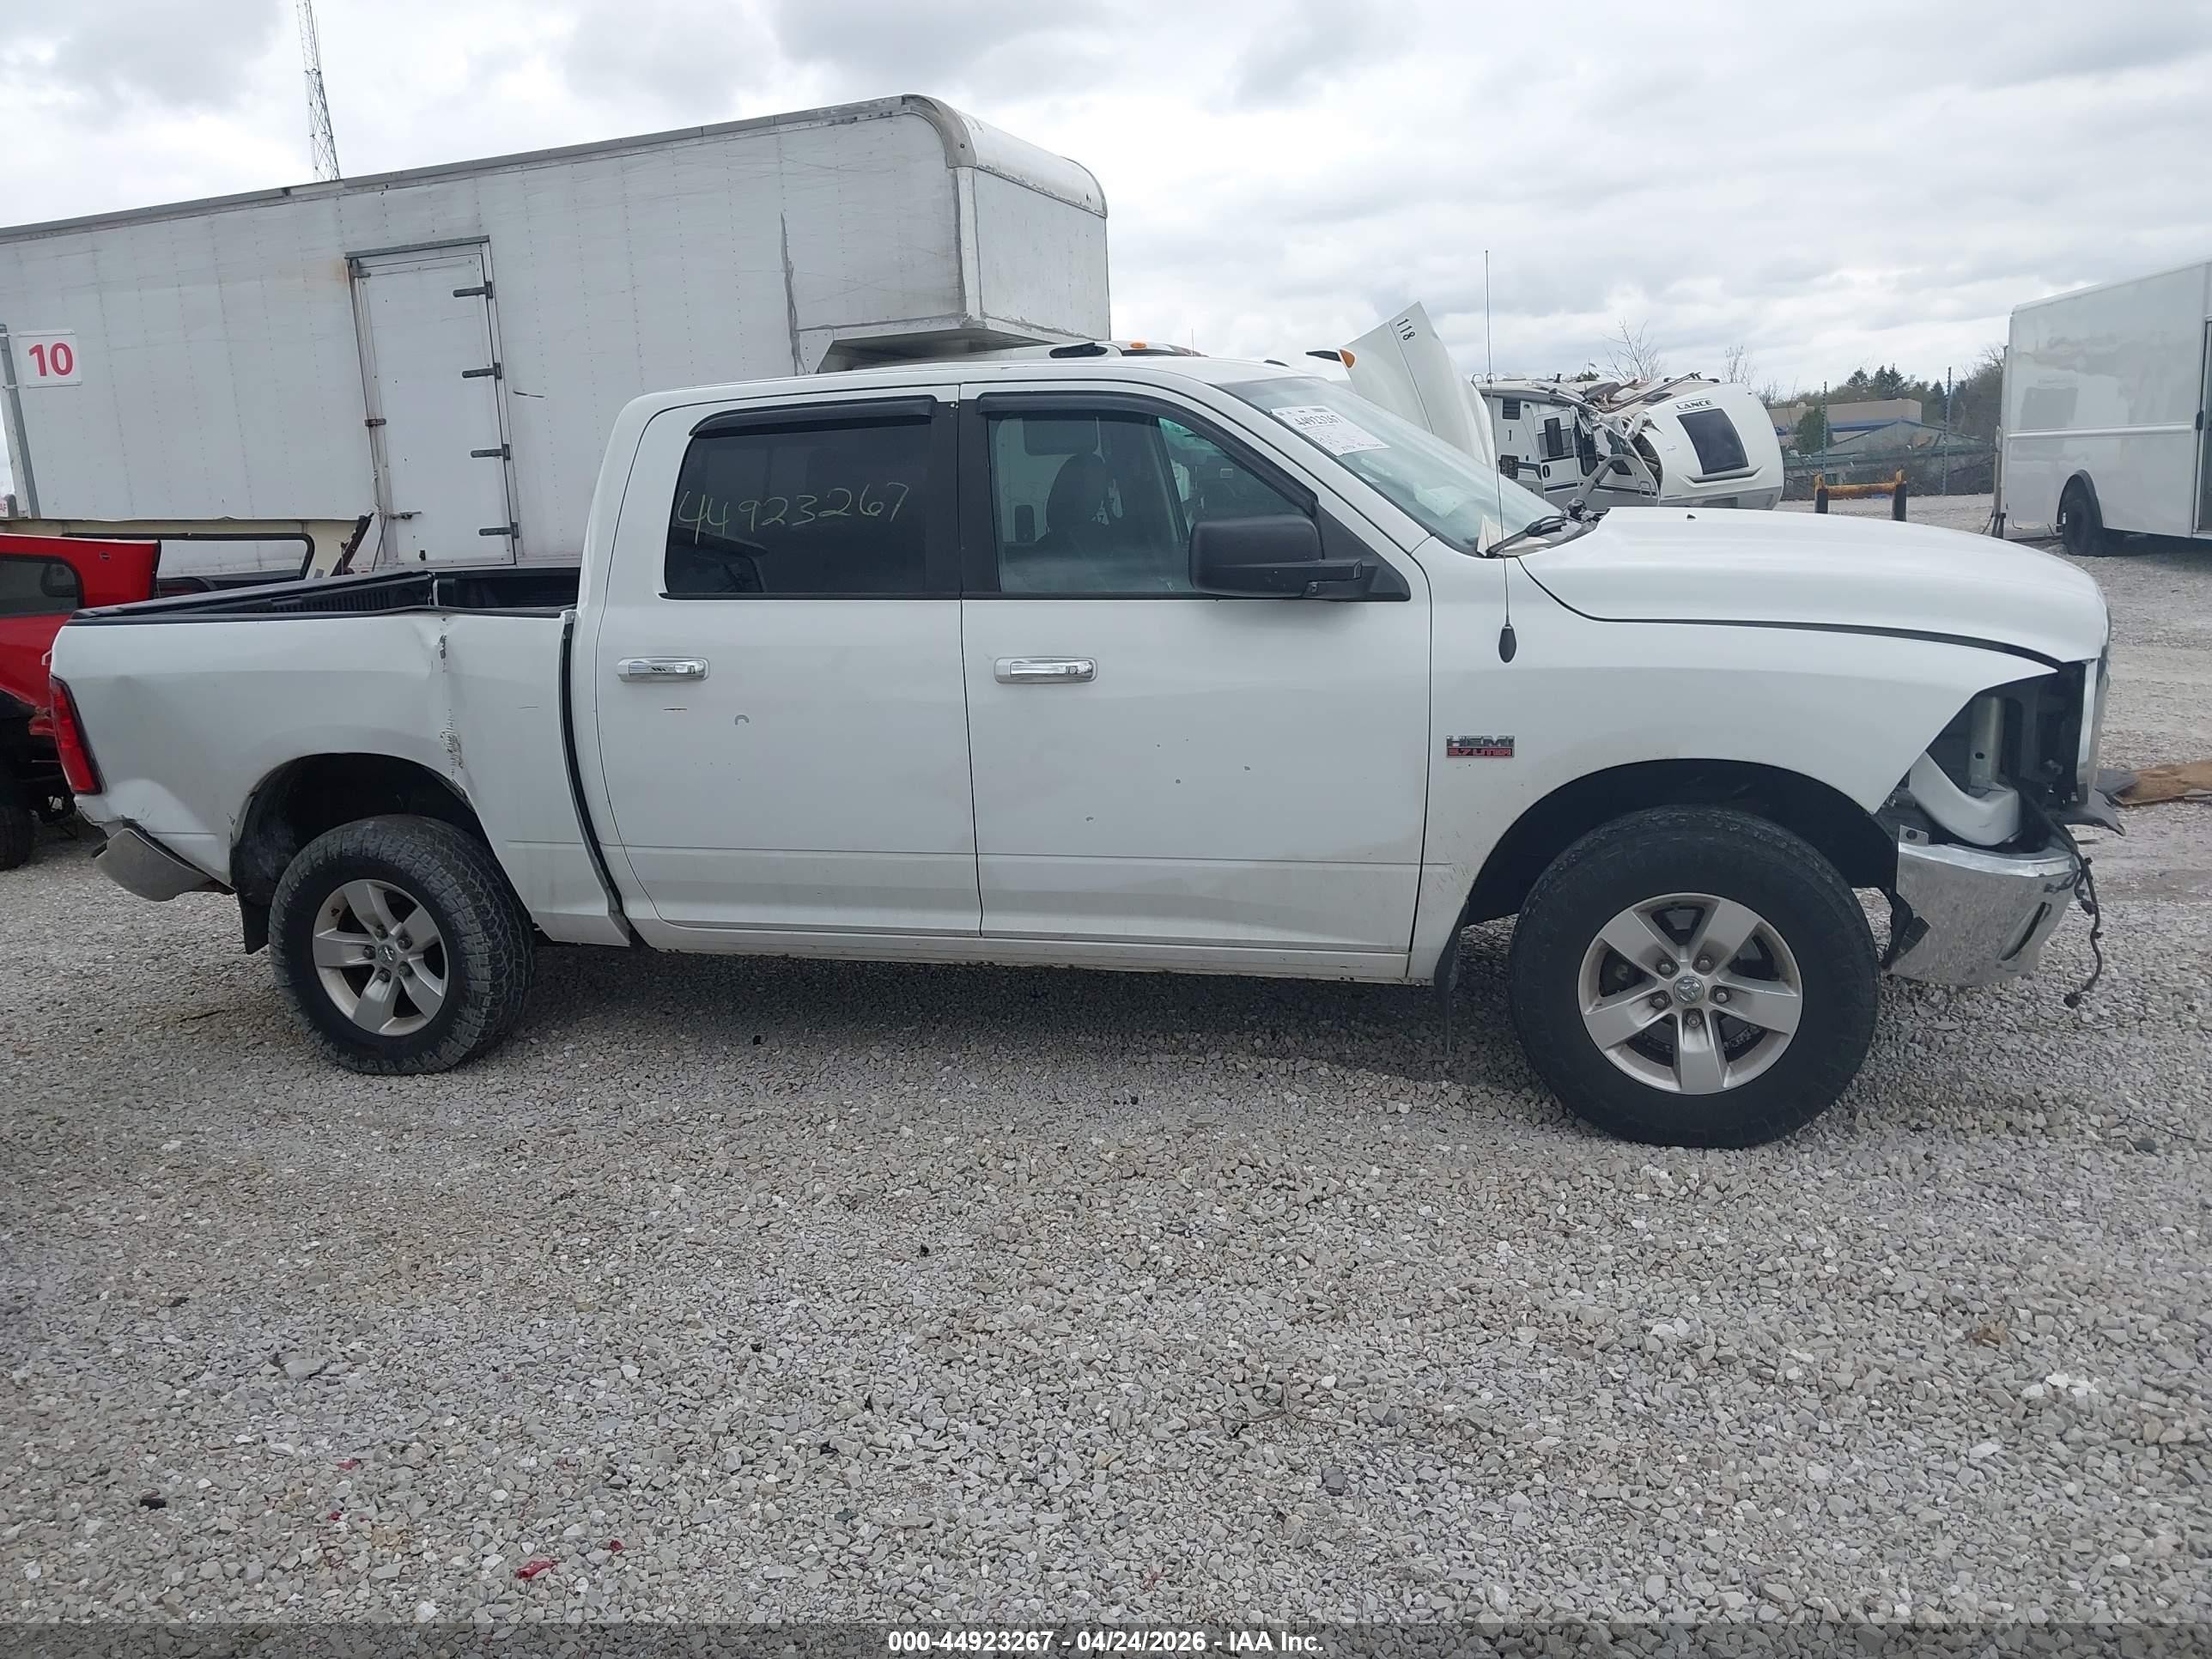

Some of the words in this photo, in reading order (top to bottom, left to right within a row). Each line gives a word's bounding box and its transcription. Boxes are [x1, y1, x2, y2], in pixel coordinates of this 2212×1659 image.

[1397, 319, 1416, 341] 118
[28, 342, 74, 377] 10
[1676, 399, 1713, 410] LANCE
[678, 482, 909, 544] 44923267
[1446, 735, 1514, 747] HEMI
